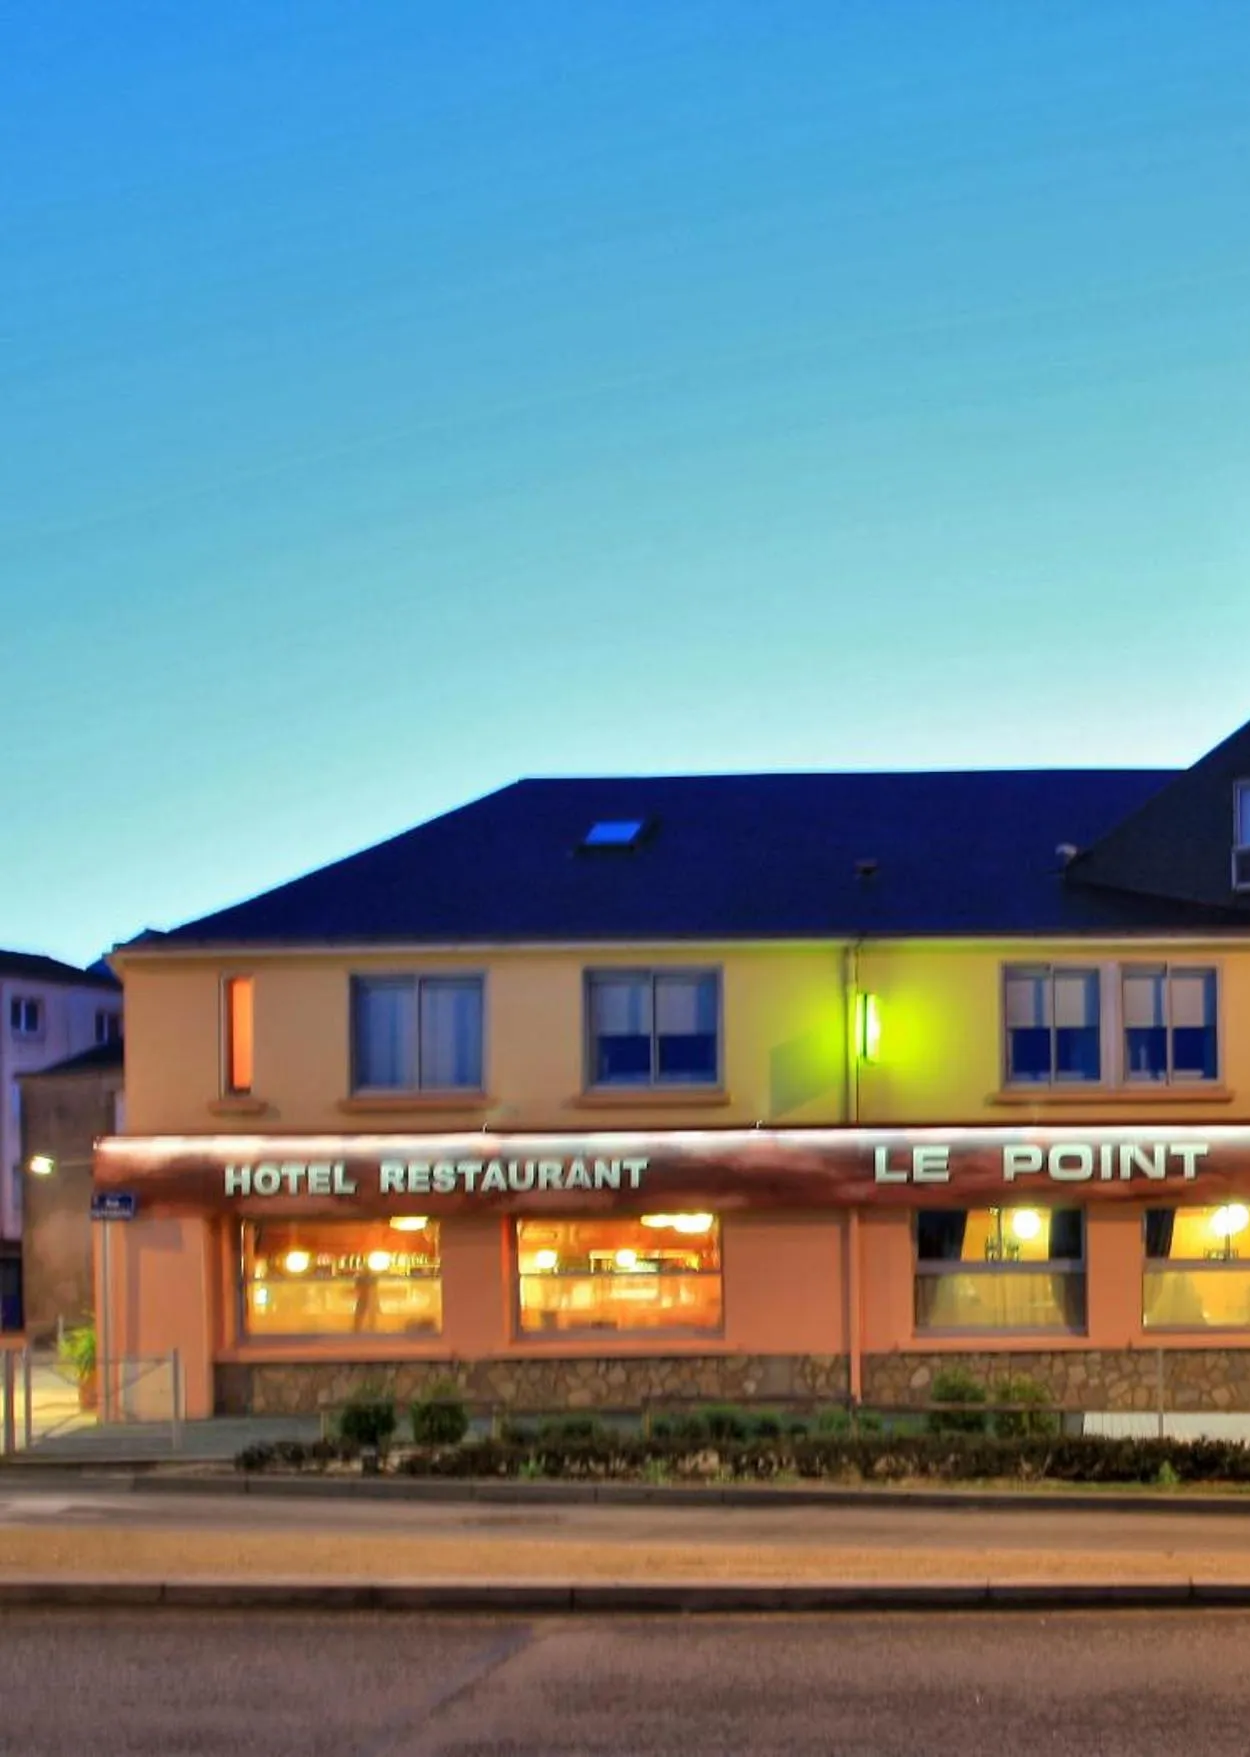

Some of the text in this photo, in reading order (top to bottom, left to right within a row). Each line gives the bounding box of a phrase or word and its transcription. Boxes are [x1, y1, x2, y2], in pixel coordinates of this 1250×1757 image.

[224, 1157, 650, 1196] HOTEL RESTAURANT
[874, 1145, 949, 1183] LE
[1003, 1143, 1209, 1182] POINT
